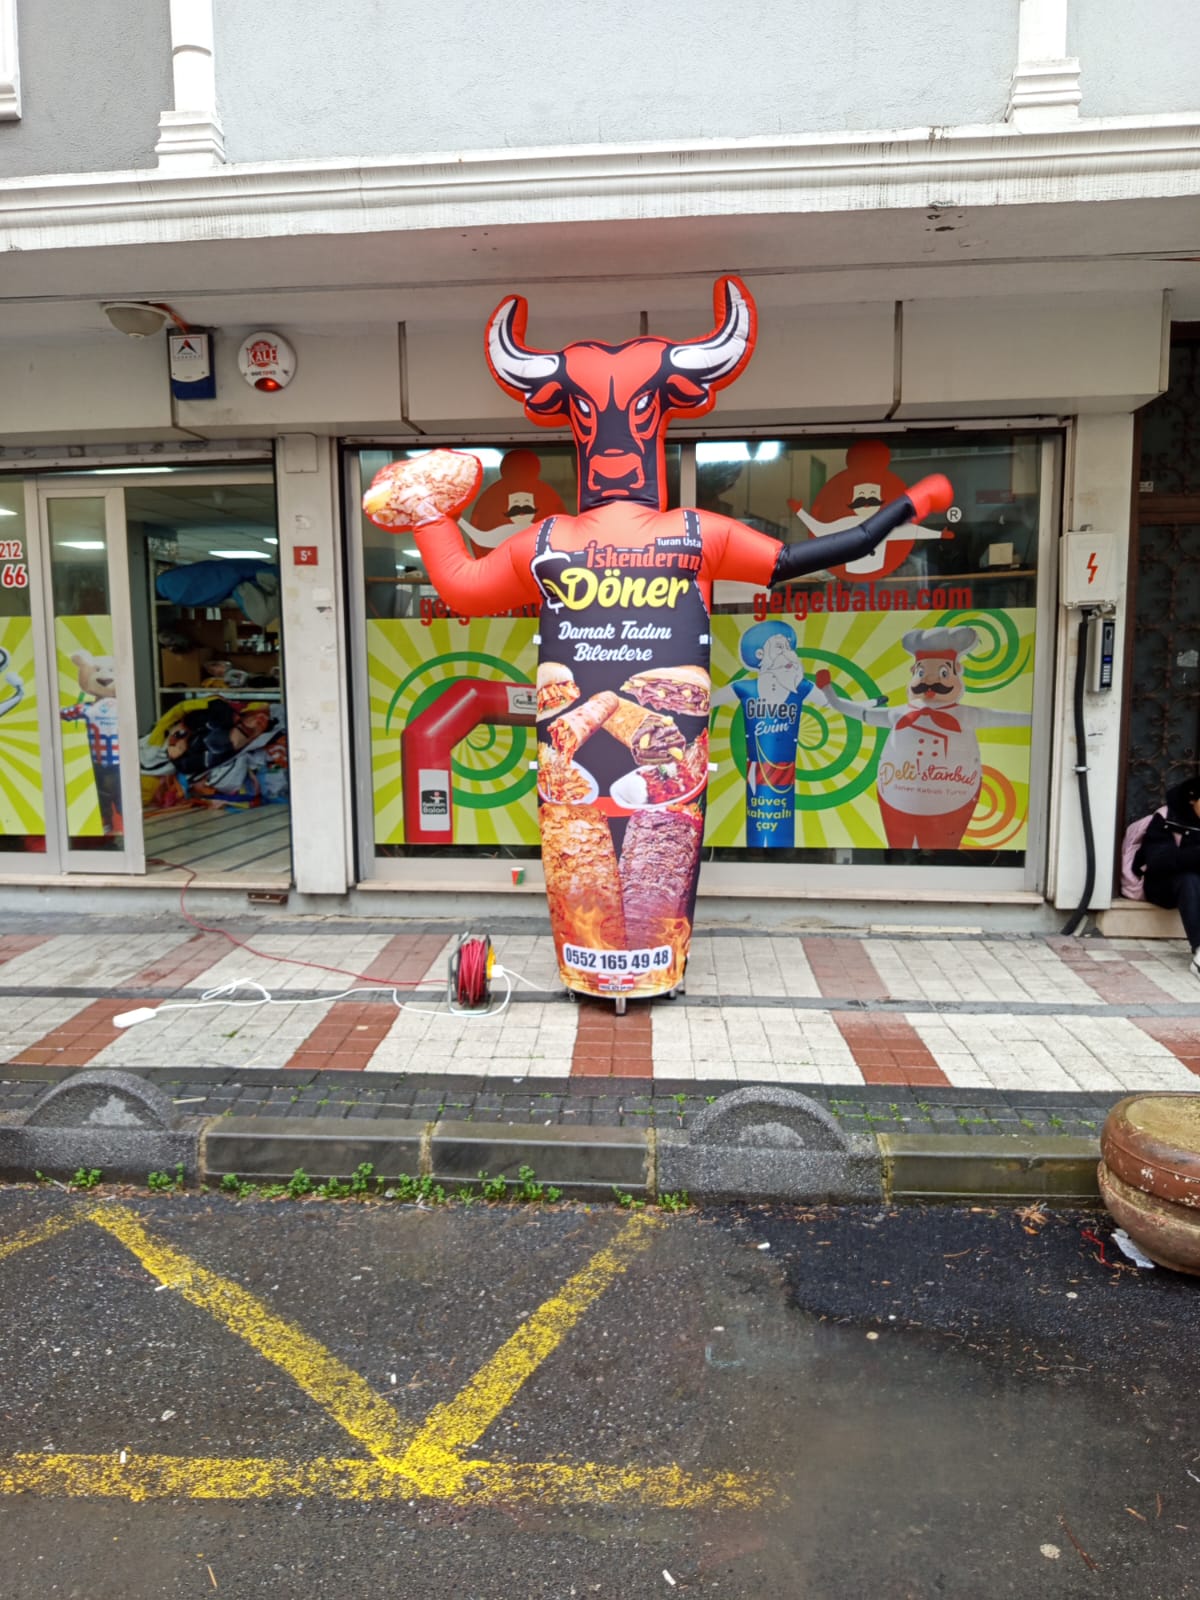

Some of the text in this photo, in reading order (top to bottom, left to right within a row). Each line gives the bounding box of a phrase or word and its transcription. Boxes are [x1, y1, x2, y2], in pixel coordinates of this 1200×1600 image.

[0, 542, 22, 558] 212
[656, 536, 701, 548] Turan Usta
[3, 565, 27, 587] 66
[551, 567, 690, 610] Döner
[753, 582, 972, 622] gelgelbalon.com
[558, 620, 672, 640] Damak Tadını
[573, 642, 653, 661] Bilenlere
[746, 699, 797, 723] Güveç
[754, 719, 789, 736] Evim
[751, 796, 787, 808] güveç
[756, 820, 778, 833] çay
[565, 947, 669, 970] 0552 165 49 48
